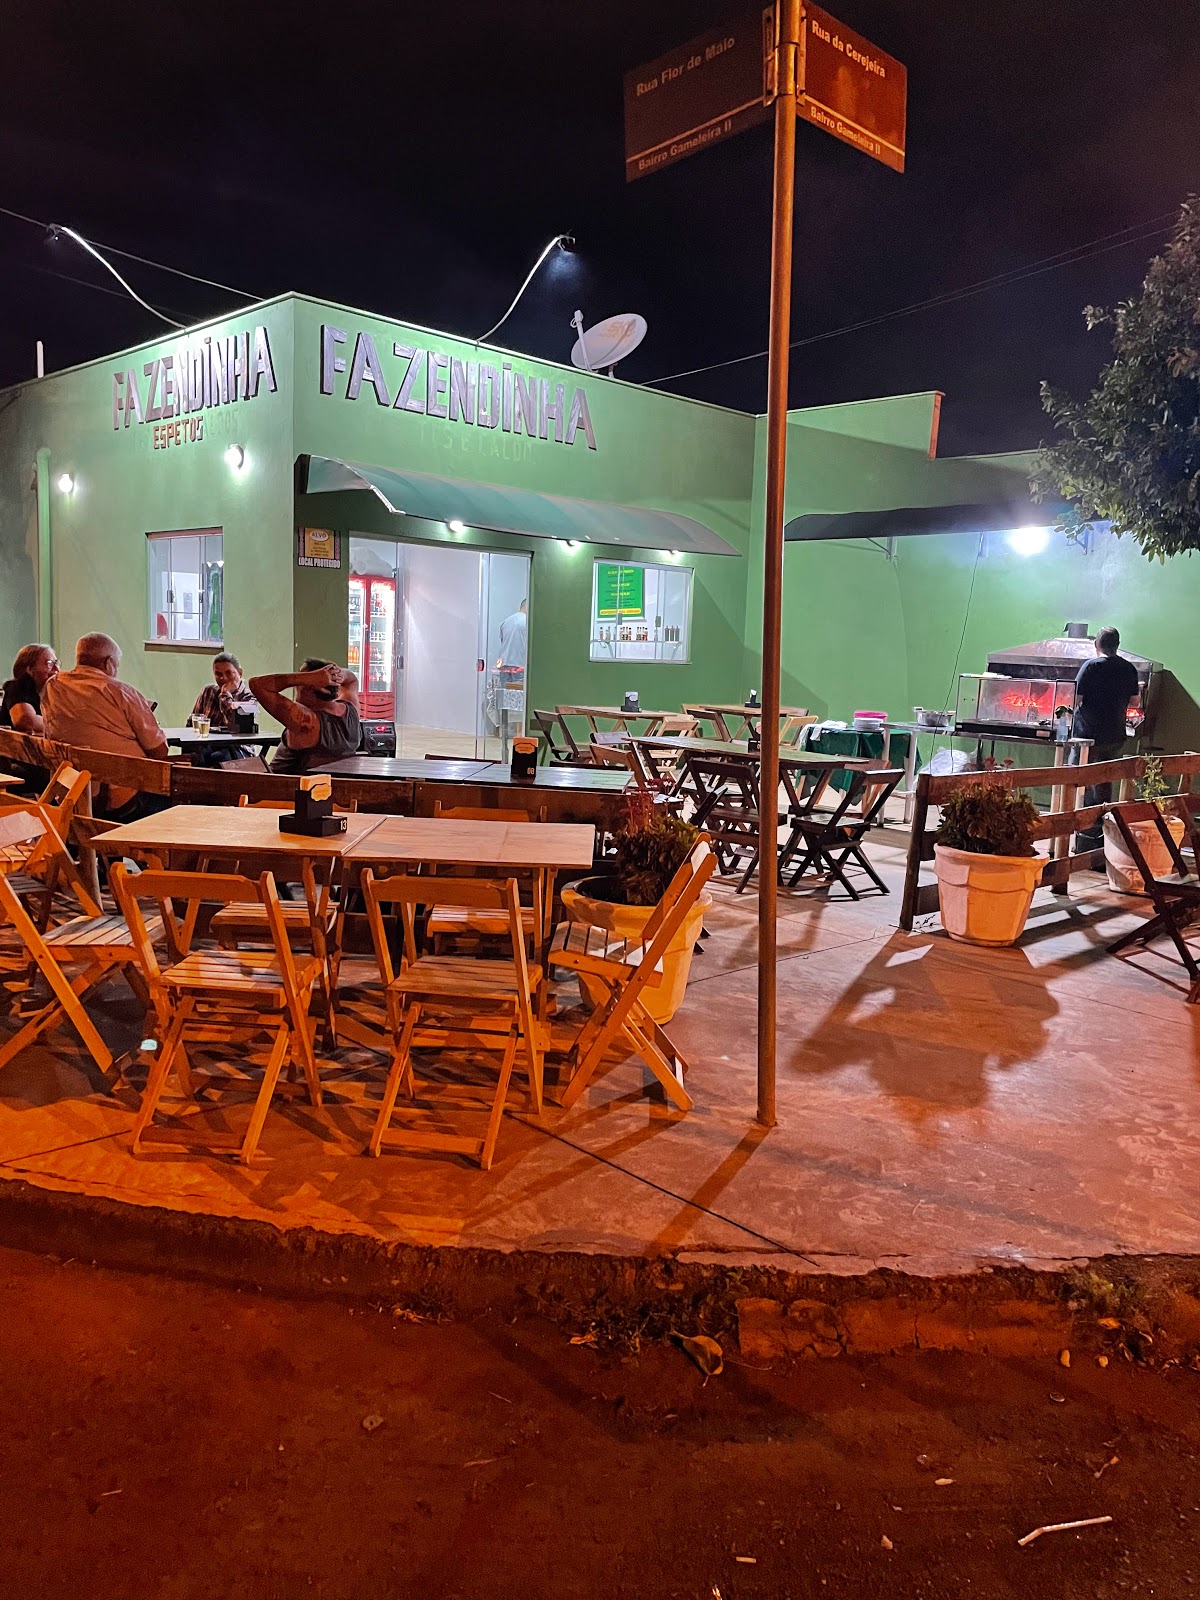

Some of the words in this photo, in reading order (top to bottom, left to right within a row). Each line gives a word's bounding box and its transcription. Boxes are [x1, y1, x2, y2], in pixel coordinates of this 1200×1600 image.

[636, 78, 658, 96] Rua
[661, 64, 684, 84] Flor
[687, 56, 702, 71] de
[705, 38, 735, 60] Maio
[812, 20, 831, 43] Rua
[832, 35, 844, 52] da
[846, 43, 886, 77] Cerejeira
[638, 151, 668, 170] Bairro
[670, 126, 721, 156] Gameleira
[810, 106, 835, 128] Bairro
[836, 121, 874, 151] Gameleira
[153, 415, 204, 449] ESPETOS
[298, 556, 314, 567] LOCAL
[340, 819, 347, 831] 13
